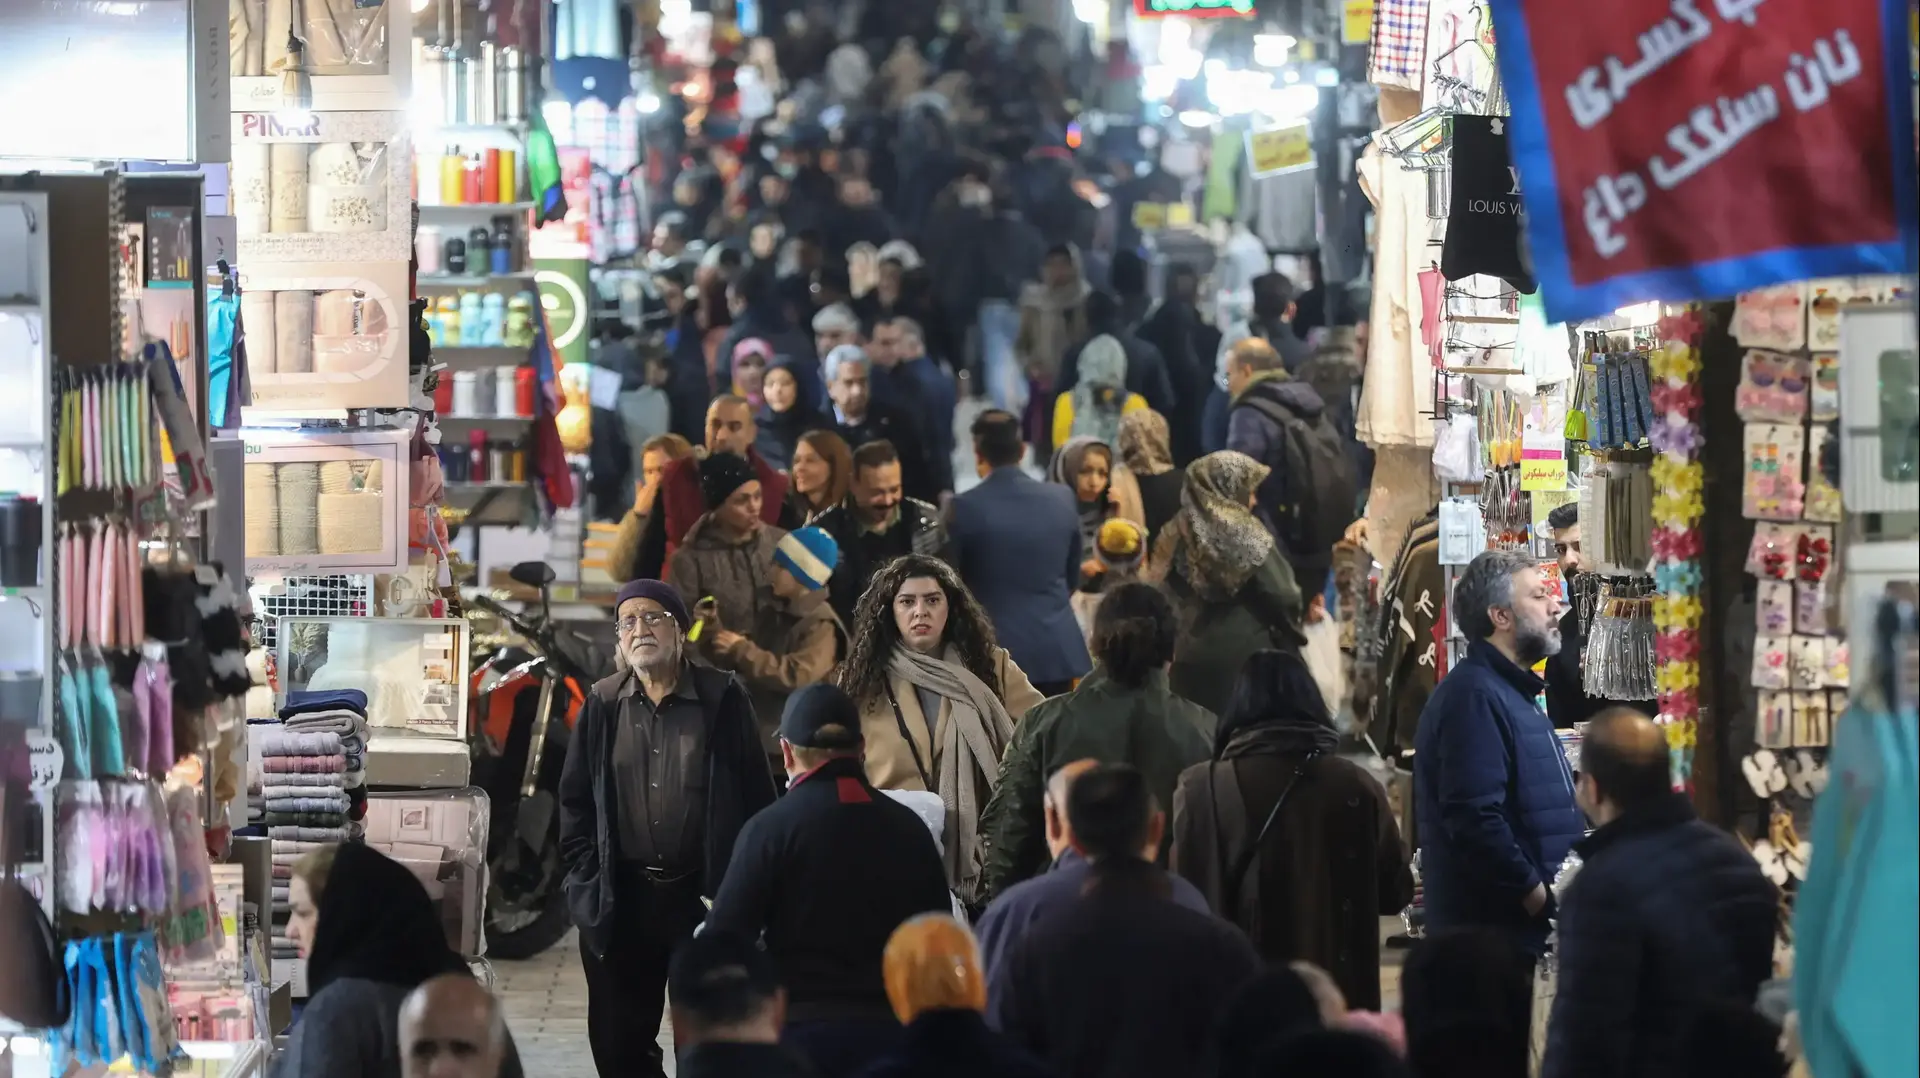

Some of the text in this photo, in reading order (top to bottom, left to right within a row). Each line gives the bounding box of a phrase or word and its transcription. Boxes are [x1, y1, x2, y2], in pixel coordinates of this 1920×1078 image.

[1784, 29, 1861, 111] نان
[1468, 199, 1506, 215] LOUIS
[1584, 173, 1646, 258] داغ
